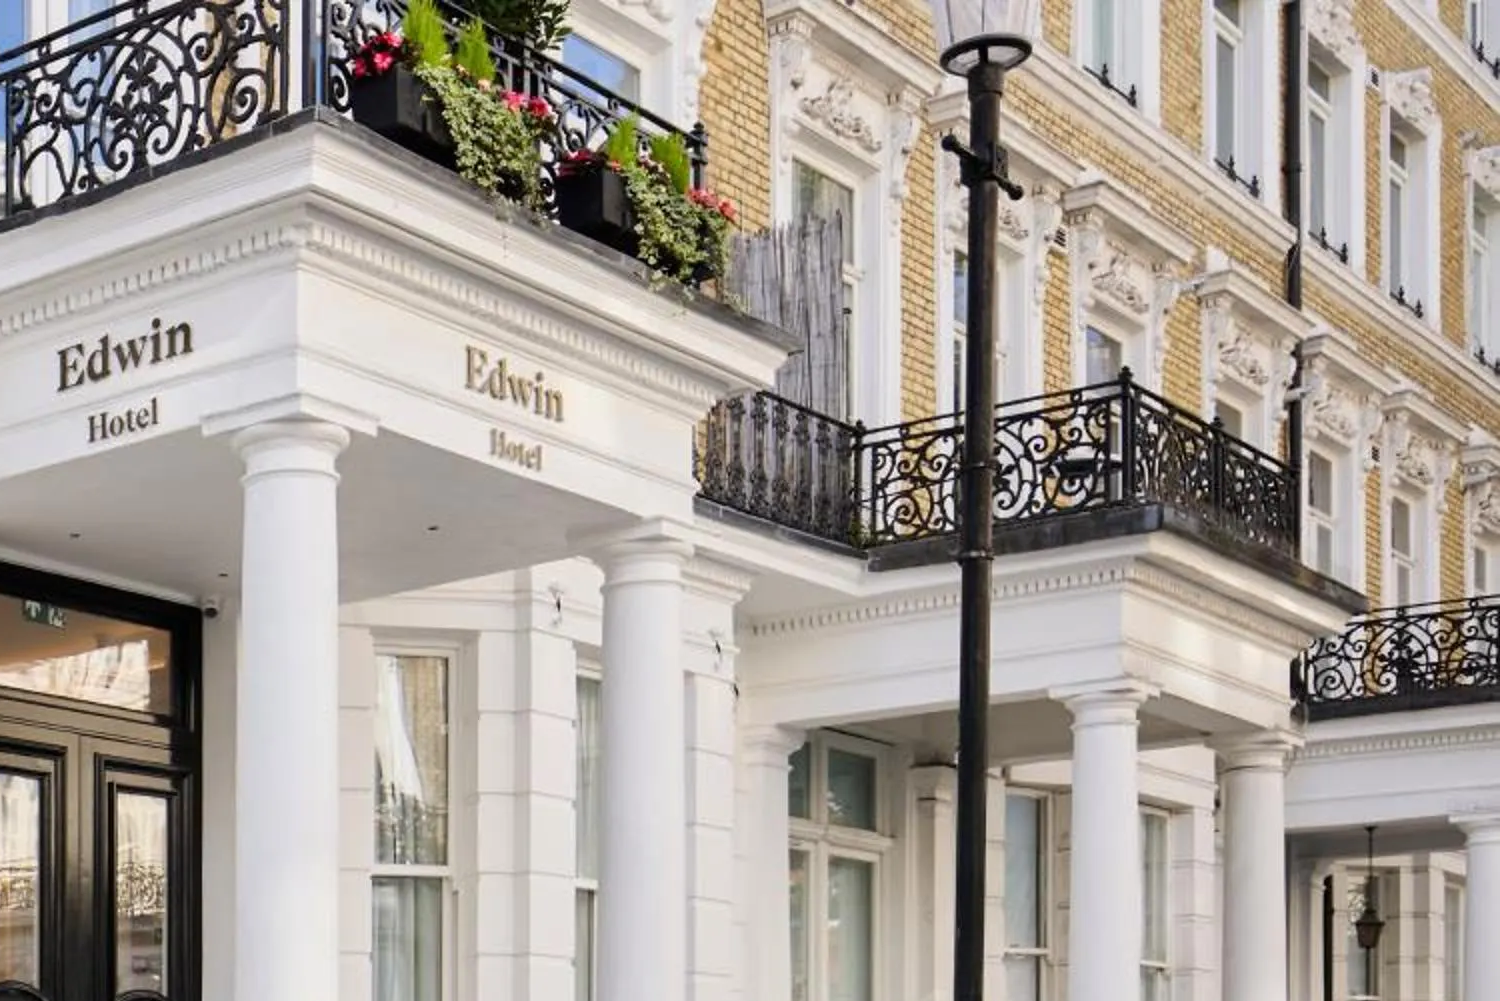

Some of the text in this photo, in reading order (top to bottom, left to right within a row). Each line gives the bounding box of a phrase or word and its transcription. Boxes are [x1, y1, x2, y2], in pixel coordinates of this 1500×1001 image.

[57, 317, 194, 392] Edwin
[466, 346, 563, 422] Edwin
[88, 397, 159, 442] Hotel
[490, 428, 542, 471] Hotel
